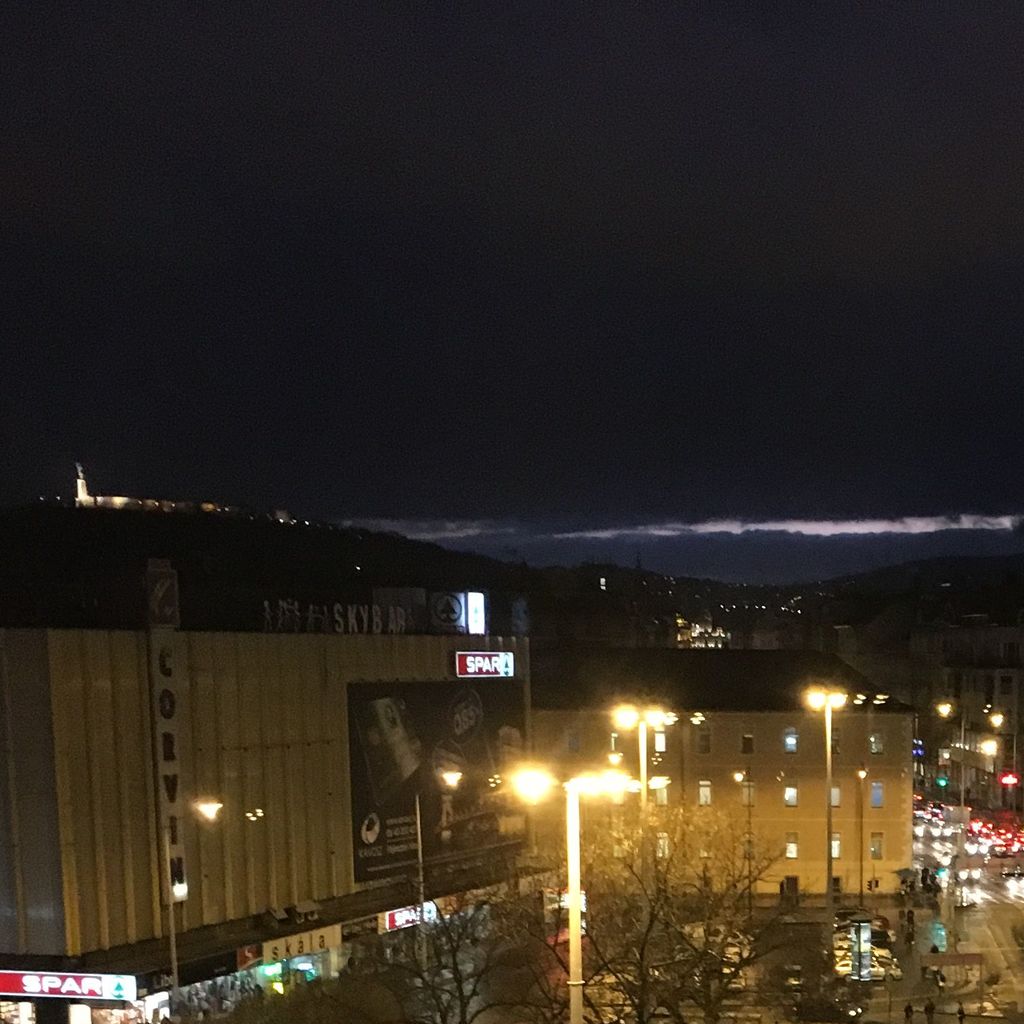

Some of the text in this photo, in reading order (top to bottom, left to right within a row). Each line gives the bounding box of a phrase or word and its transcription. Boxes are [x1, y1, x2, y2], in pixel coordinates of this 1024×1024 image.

[467, 656, 499, 673] SPAR
[159, 651, 185, 885] CORVIN
[22, 975, 102, 995] SPAR
